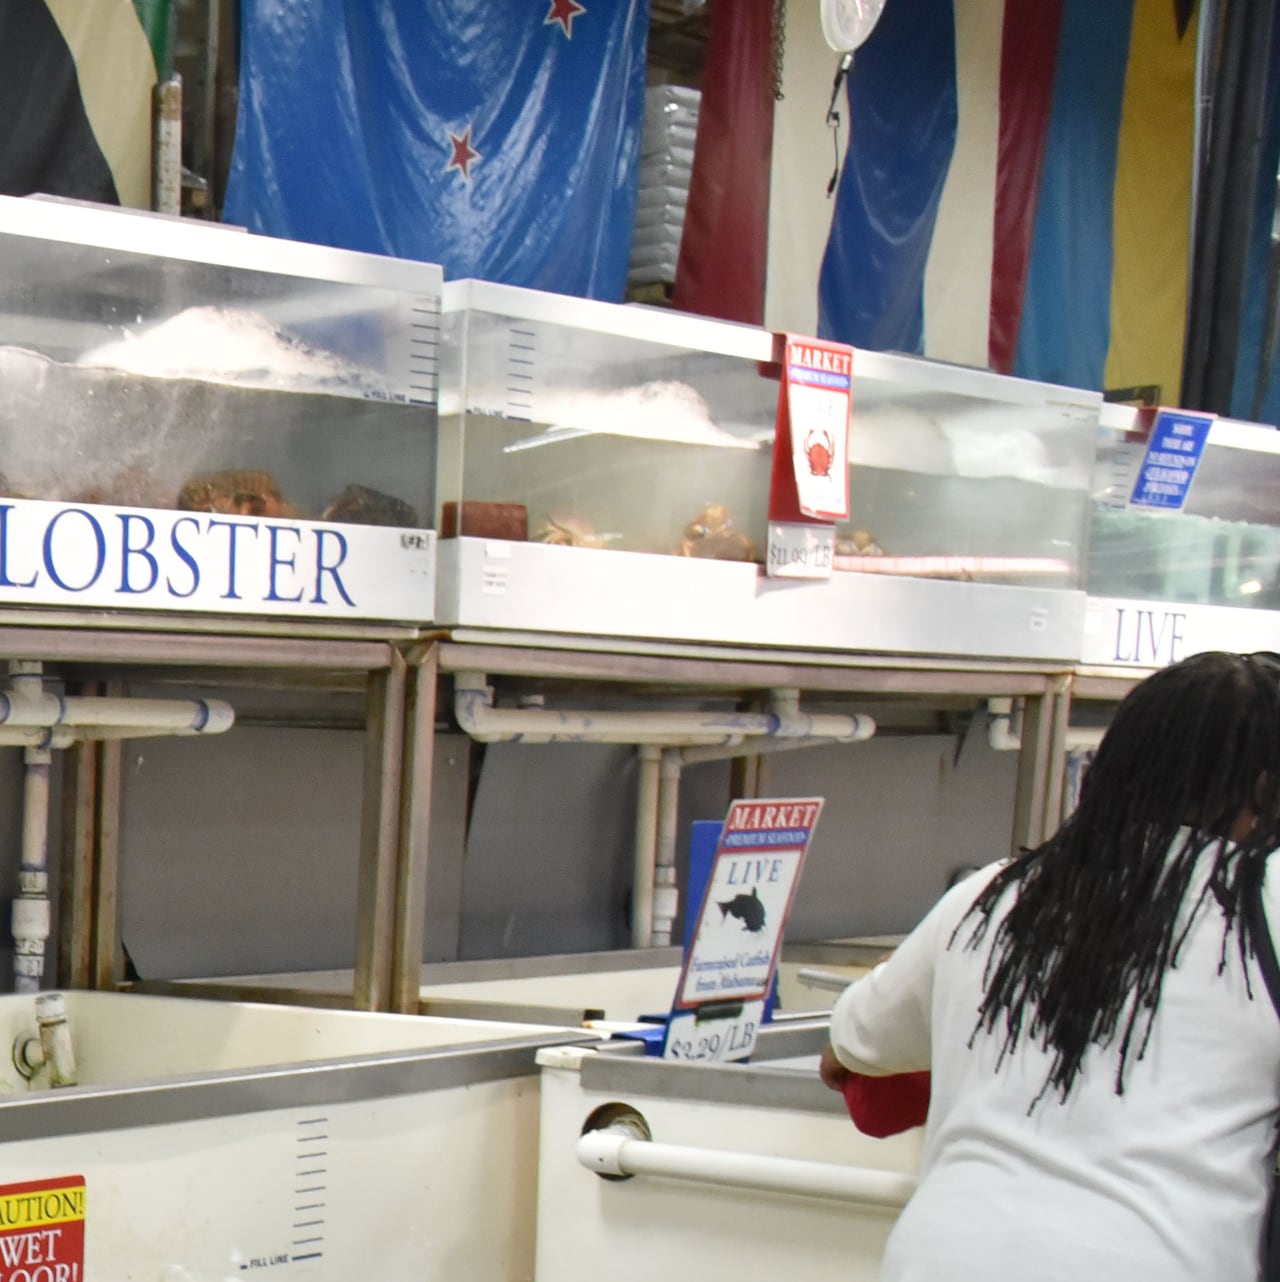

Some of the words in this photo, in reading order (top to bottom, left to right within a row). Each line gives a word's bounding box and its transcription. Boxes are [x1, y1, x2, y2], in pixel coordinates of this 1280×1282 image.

[792, 345, 850, 375] MARKET
[1113, 608, 1187, 665] LIVE
[729, 804, 817, 829] MARKET
[727, 859, 783, 885] LIVE
